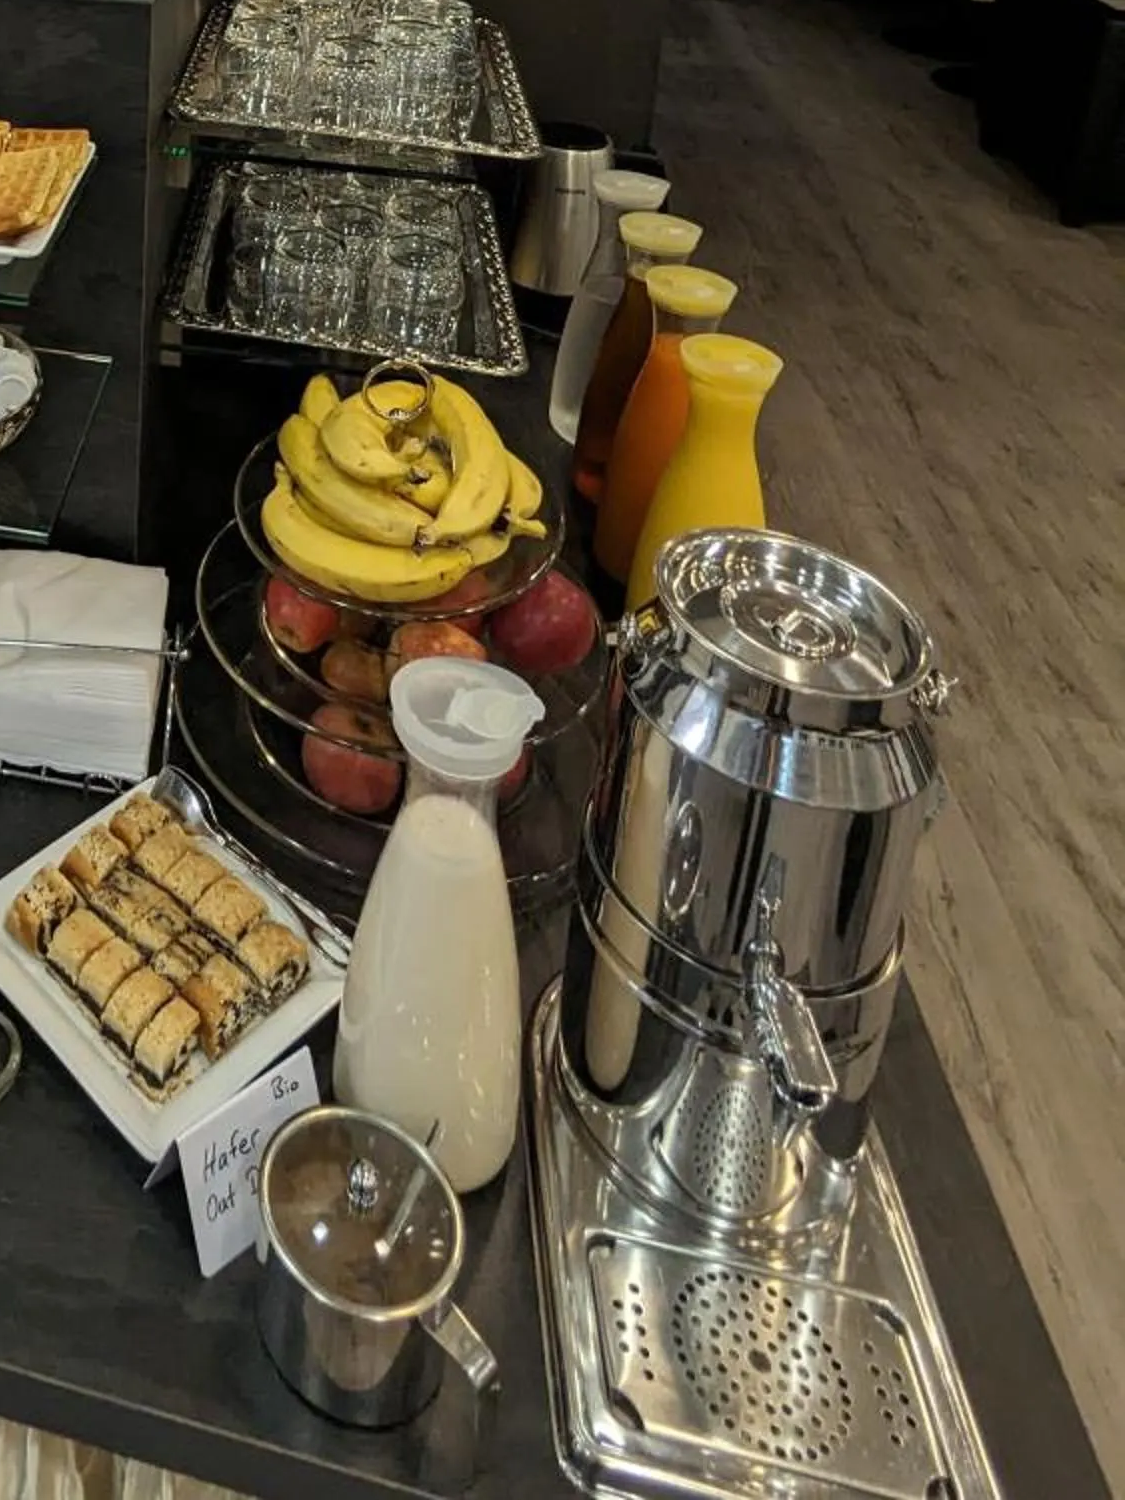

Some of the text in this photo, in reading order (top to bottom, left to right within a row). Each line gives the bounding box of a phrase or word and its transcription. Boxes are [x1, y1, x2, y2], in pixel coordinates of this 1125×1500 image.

[270, 1074, 300, 1100] Bio
[203, 1127, 260, 1184] Hafer
[206, 1184, 236, 1223] Oat
